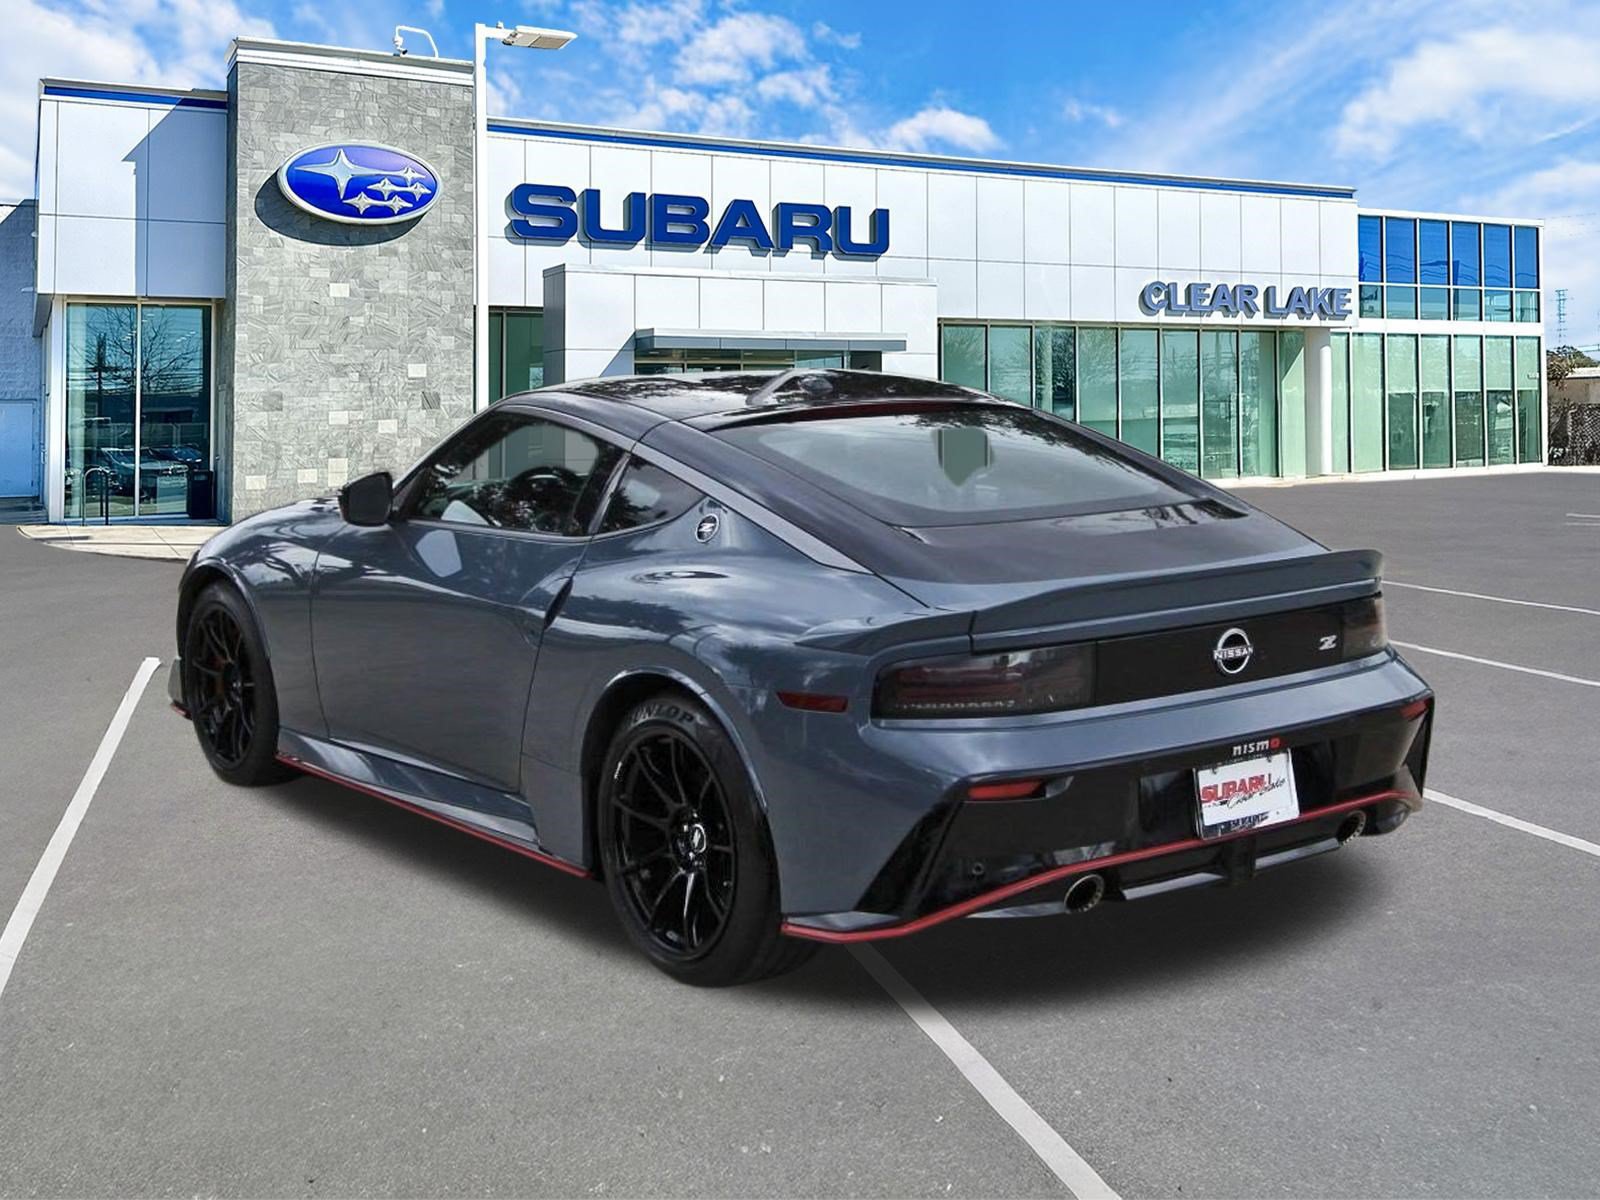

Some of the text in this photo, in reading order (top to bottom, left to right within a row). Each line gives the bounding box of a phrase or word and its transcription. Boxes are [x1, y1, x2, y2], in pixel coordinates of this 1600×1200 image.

[505, 183, 890, 262] SUBARU
[1139, 280, 1352, 320] CLEAR LAKE
[1213, 643, 1254, 661] NISSAN
